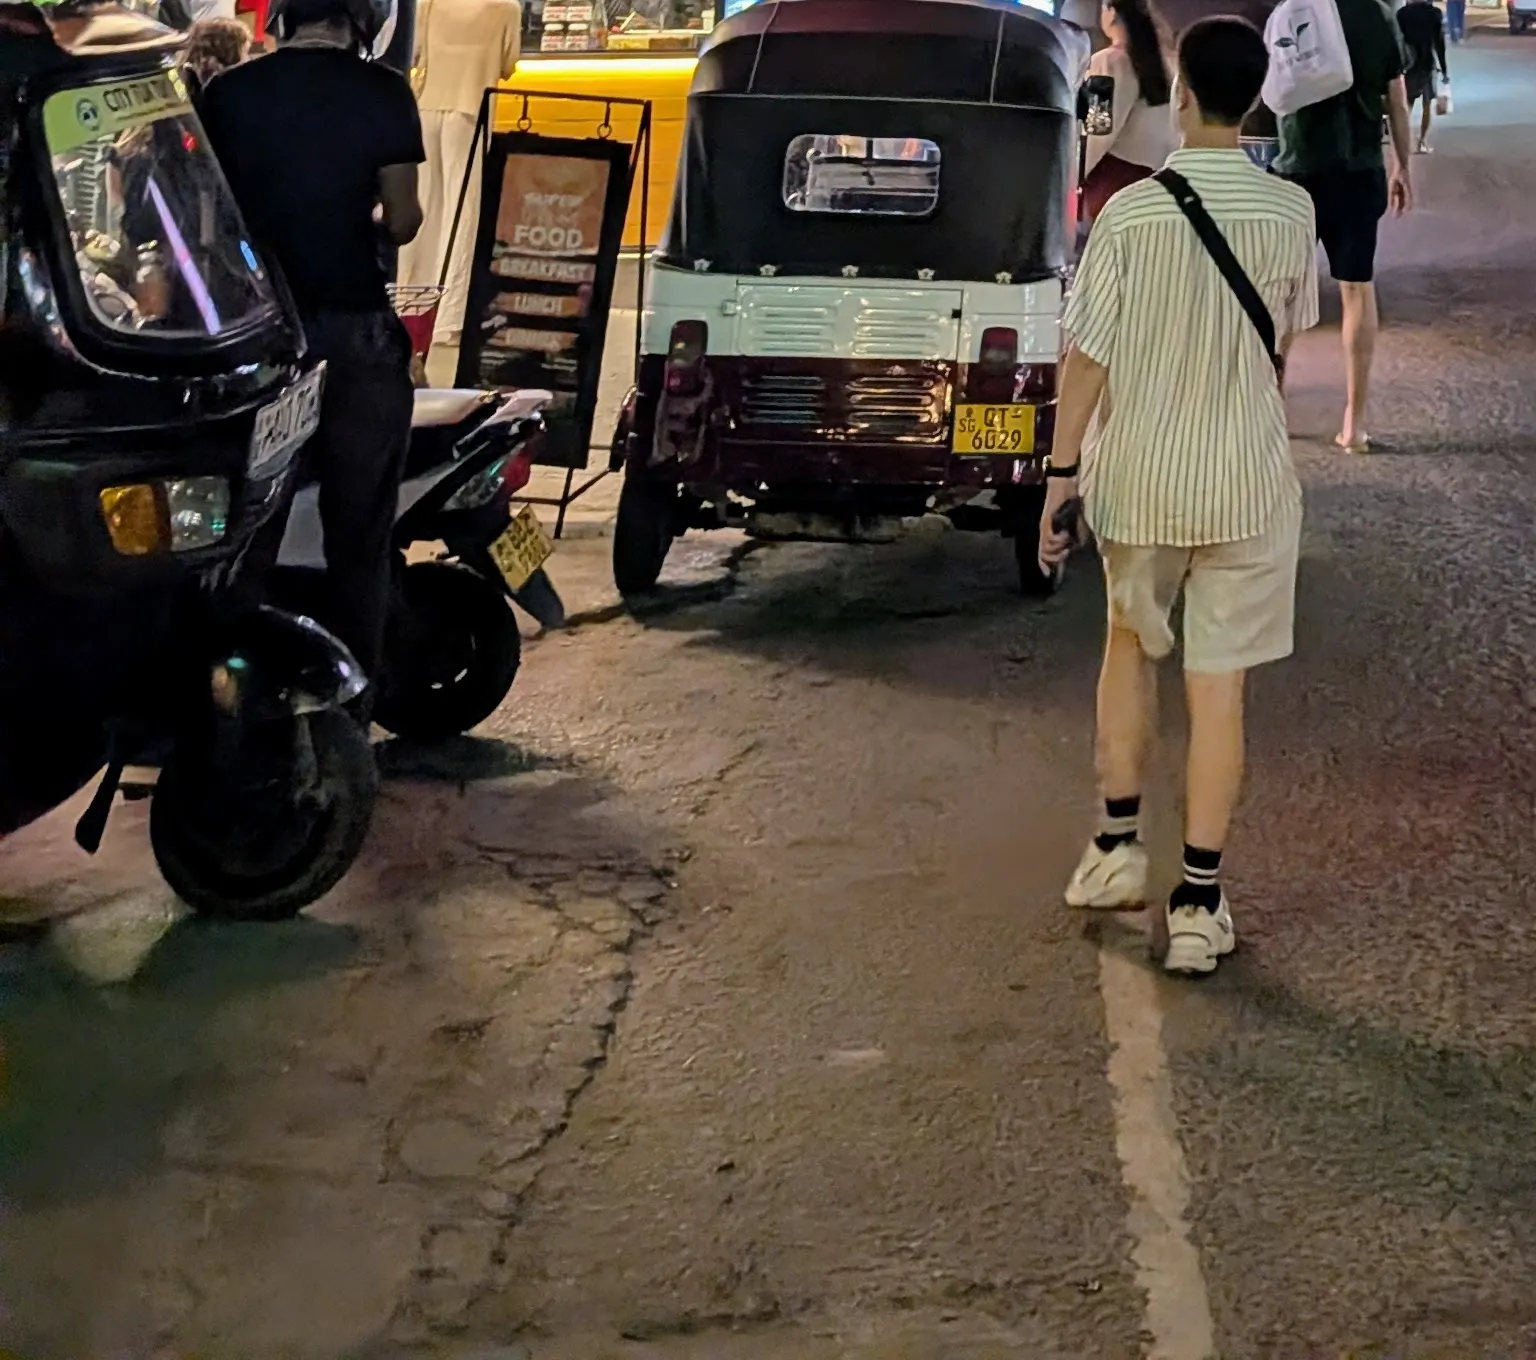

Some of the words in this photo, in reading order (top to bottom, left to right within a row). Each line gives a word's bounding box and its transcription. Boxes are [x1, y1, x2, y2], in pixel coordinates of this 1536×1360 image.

[514, 225, 584, 247] FOOD
[499, 256, 589, 280] BREAKFAST
[513, 294, 563, 313] LUNCH
[958, 417, 977, 433] SG
[971, 428, 1022, 451] 6029
